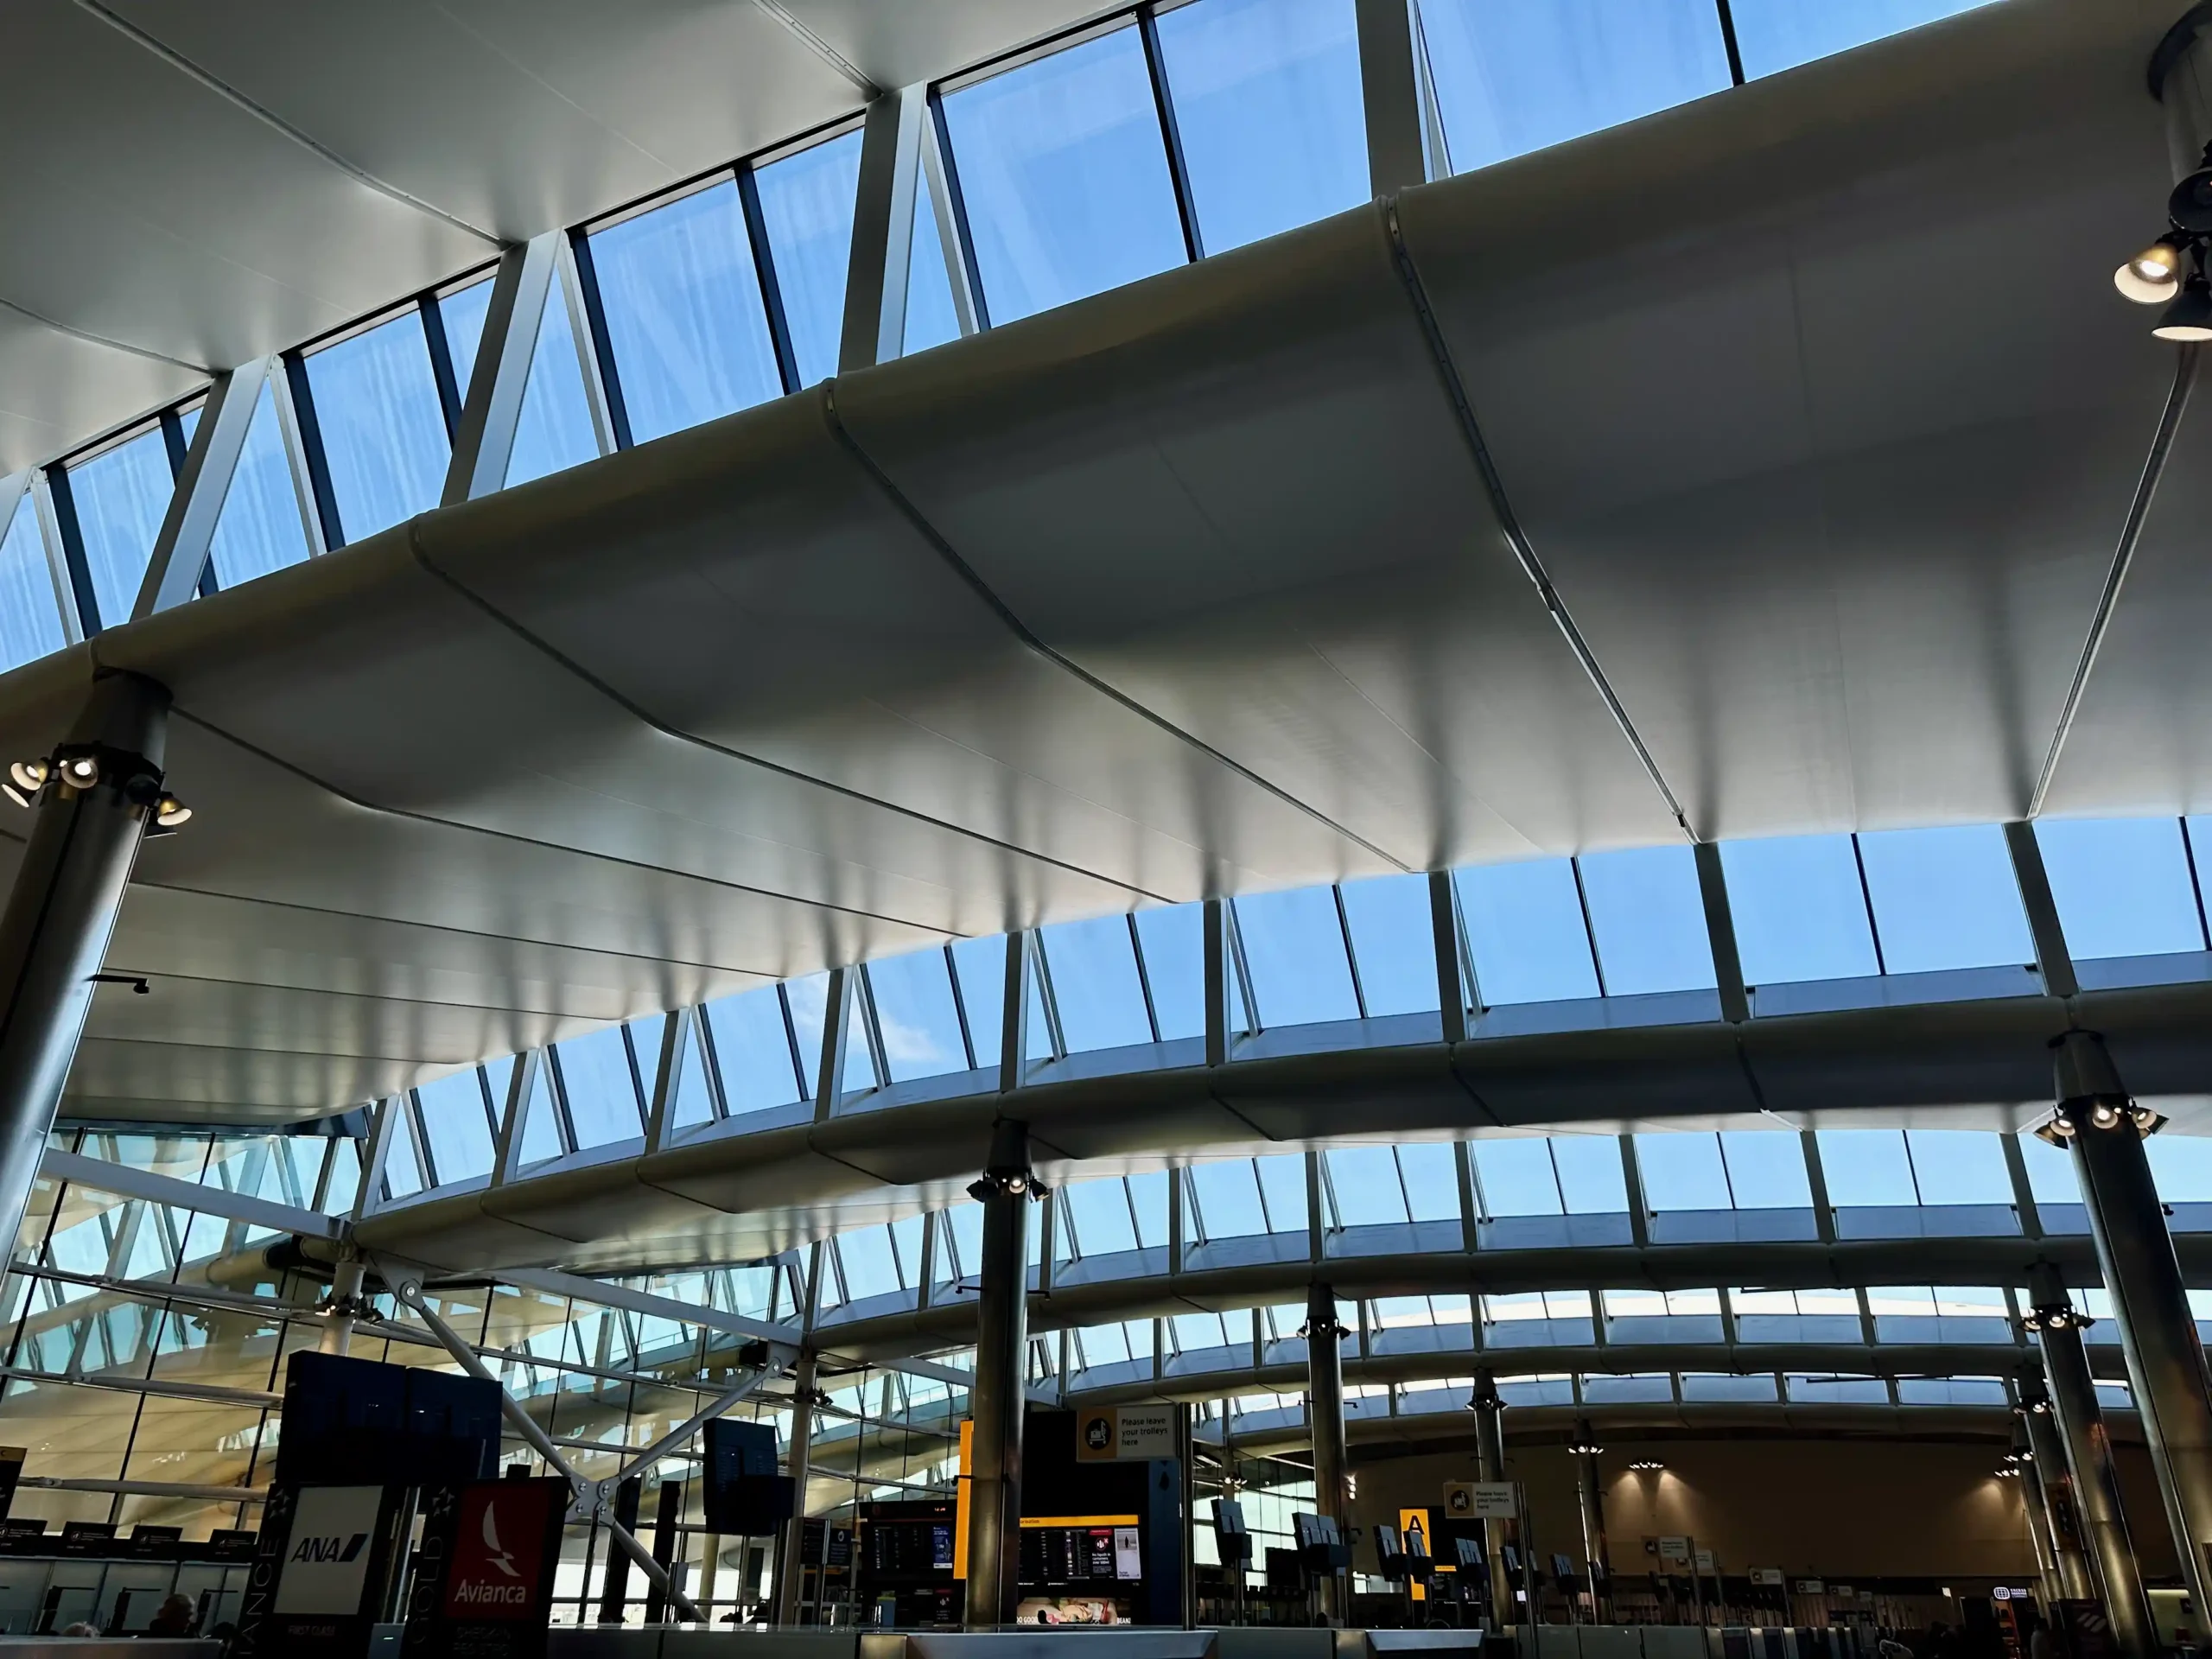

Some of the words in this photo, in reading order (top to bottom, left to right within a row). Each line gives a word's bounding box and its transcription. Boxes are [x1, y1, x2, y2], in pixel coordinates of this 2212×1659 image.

[1122, 1429, 1139, 1438] your
[1140, 1427, 1168, 1436] trolleys
[1408, 1515, 1425, 1535] A
[290, 1537, 341, 1562] ANA
[410, 1535, 444, 1644] GOLD
[454, 1579, 526, 1604] Avianca
